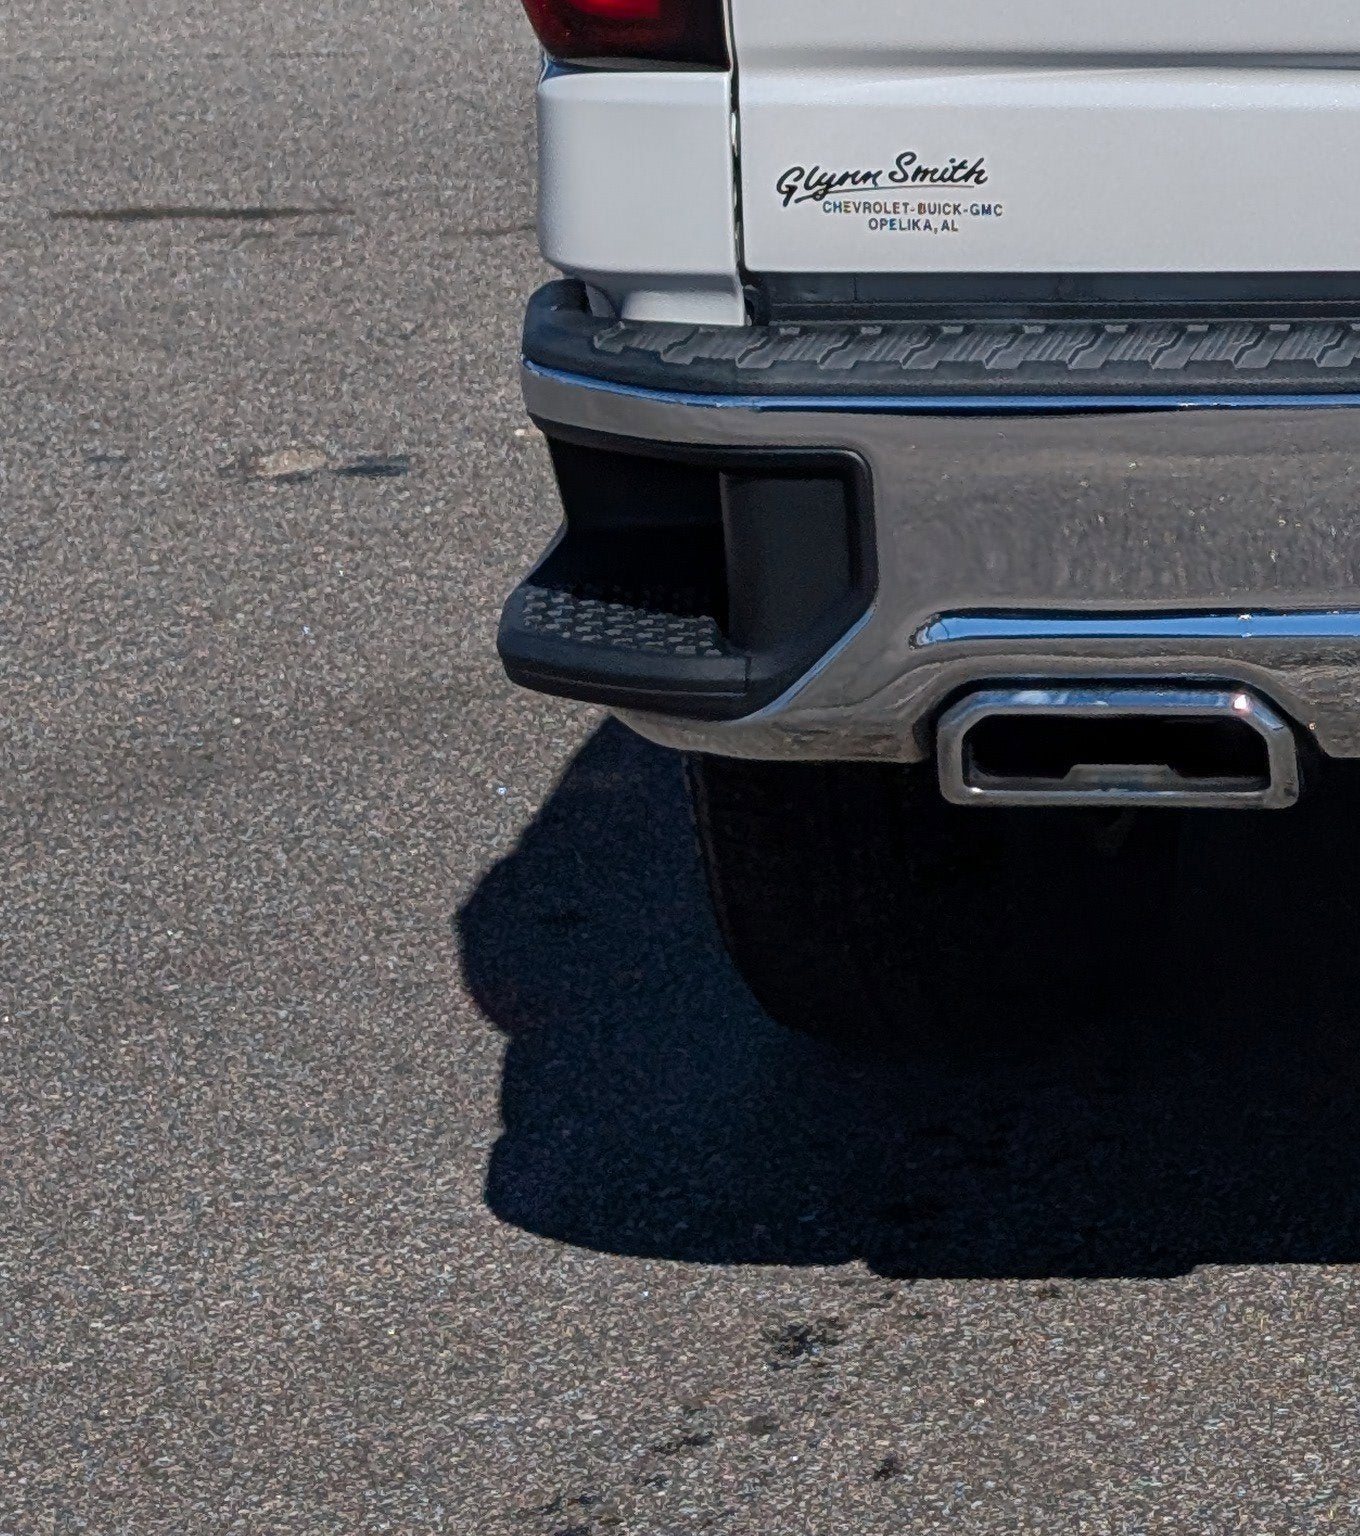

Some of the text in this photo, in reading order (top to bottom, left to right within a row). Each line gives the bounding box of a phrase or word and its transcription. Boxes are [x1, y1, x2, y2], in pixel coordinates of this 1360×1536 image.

[776, 151, 989, 208] Glynn Smith
[822, 200, 1003, 217] CHEVROLET-BUICK-GMC
[868, 217, 959, 234] OPELIKA, AL
